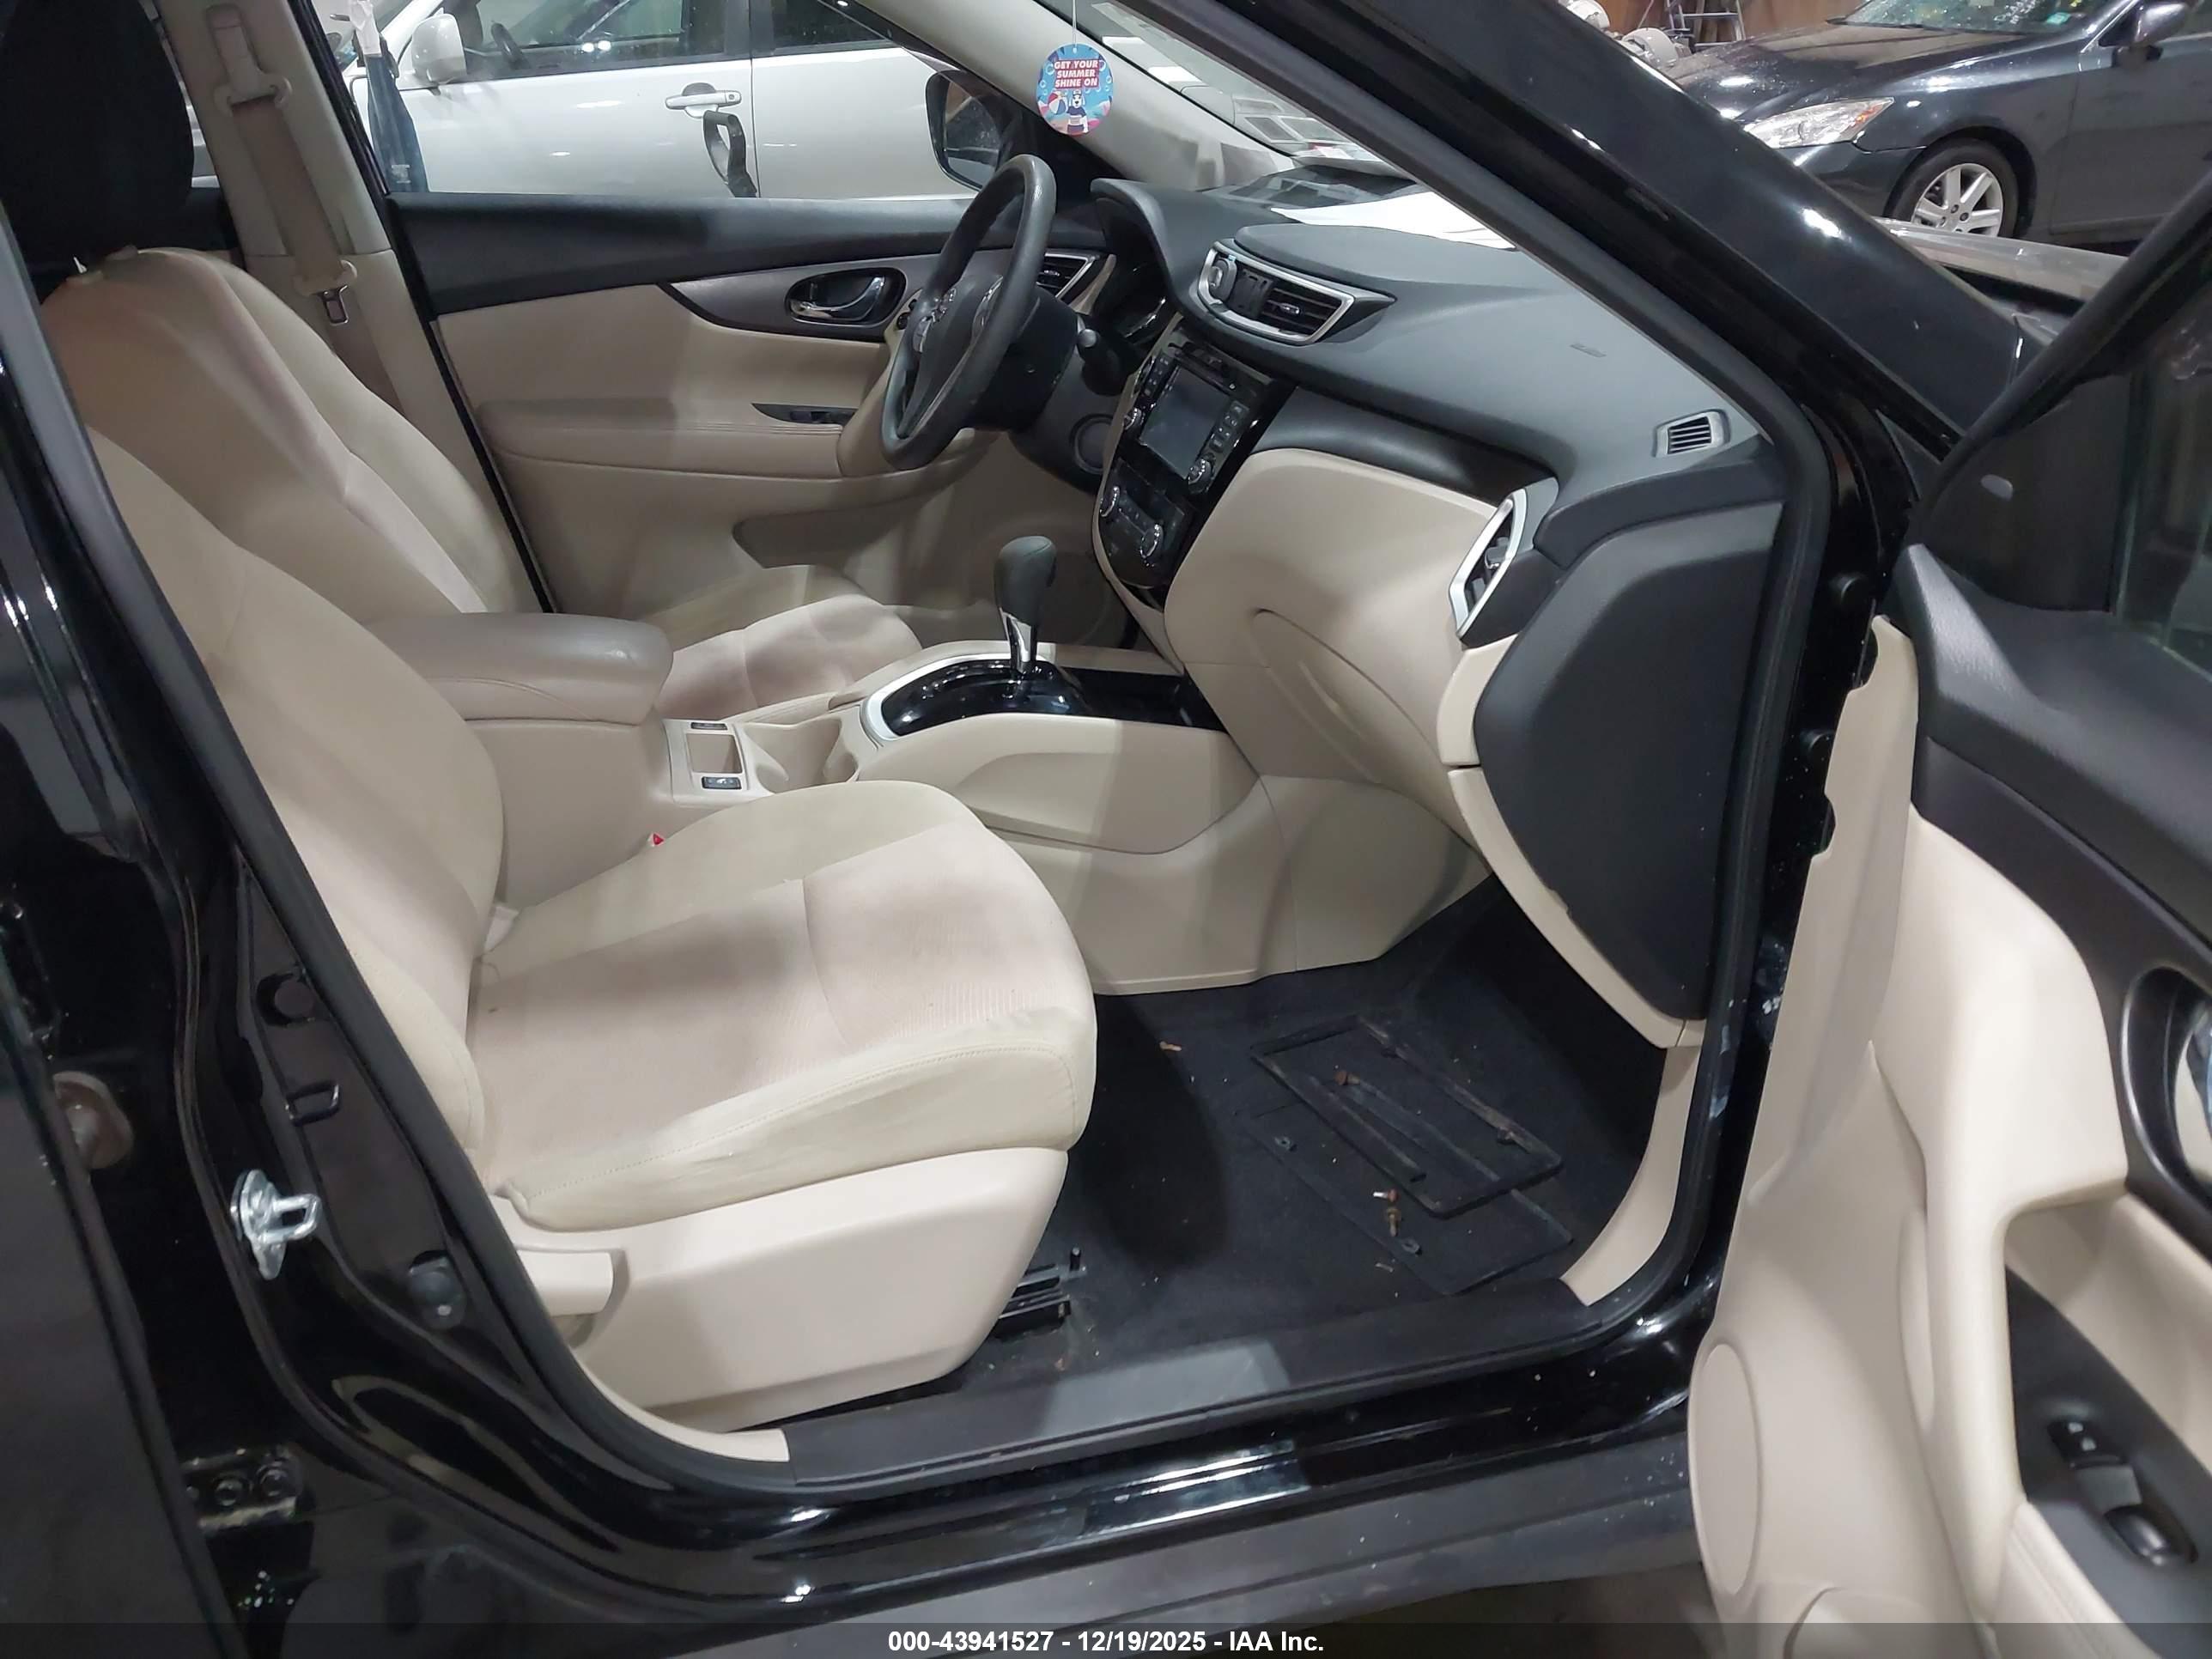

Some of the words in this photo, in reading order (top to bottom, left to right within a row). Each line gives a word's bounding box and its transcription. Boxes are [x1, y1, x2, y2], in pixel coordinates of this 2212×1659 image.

[1054, 61, 1072, 70] GET
[1073, 60, 1098, 69] YOUR
[1057, 69, 1096, 78] SUMMER
[1055, 78, 1081, 88] SHINE
